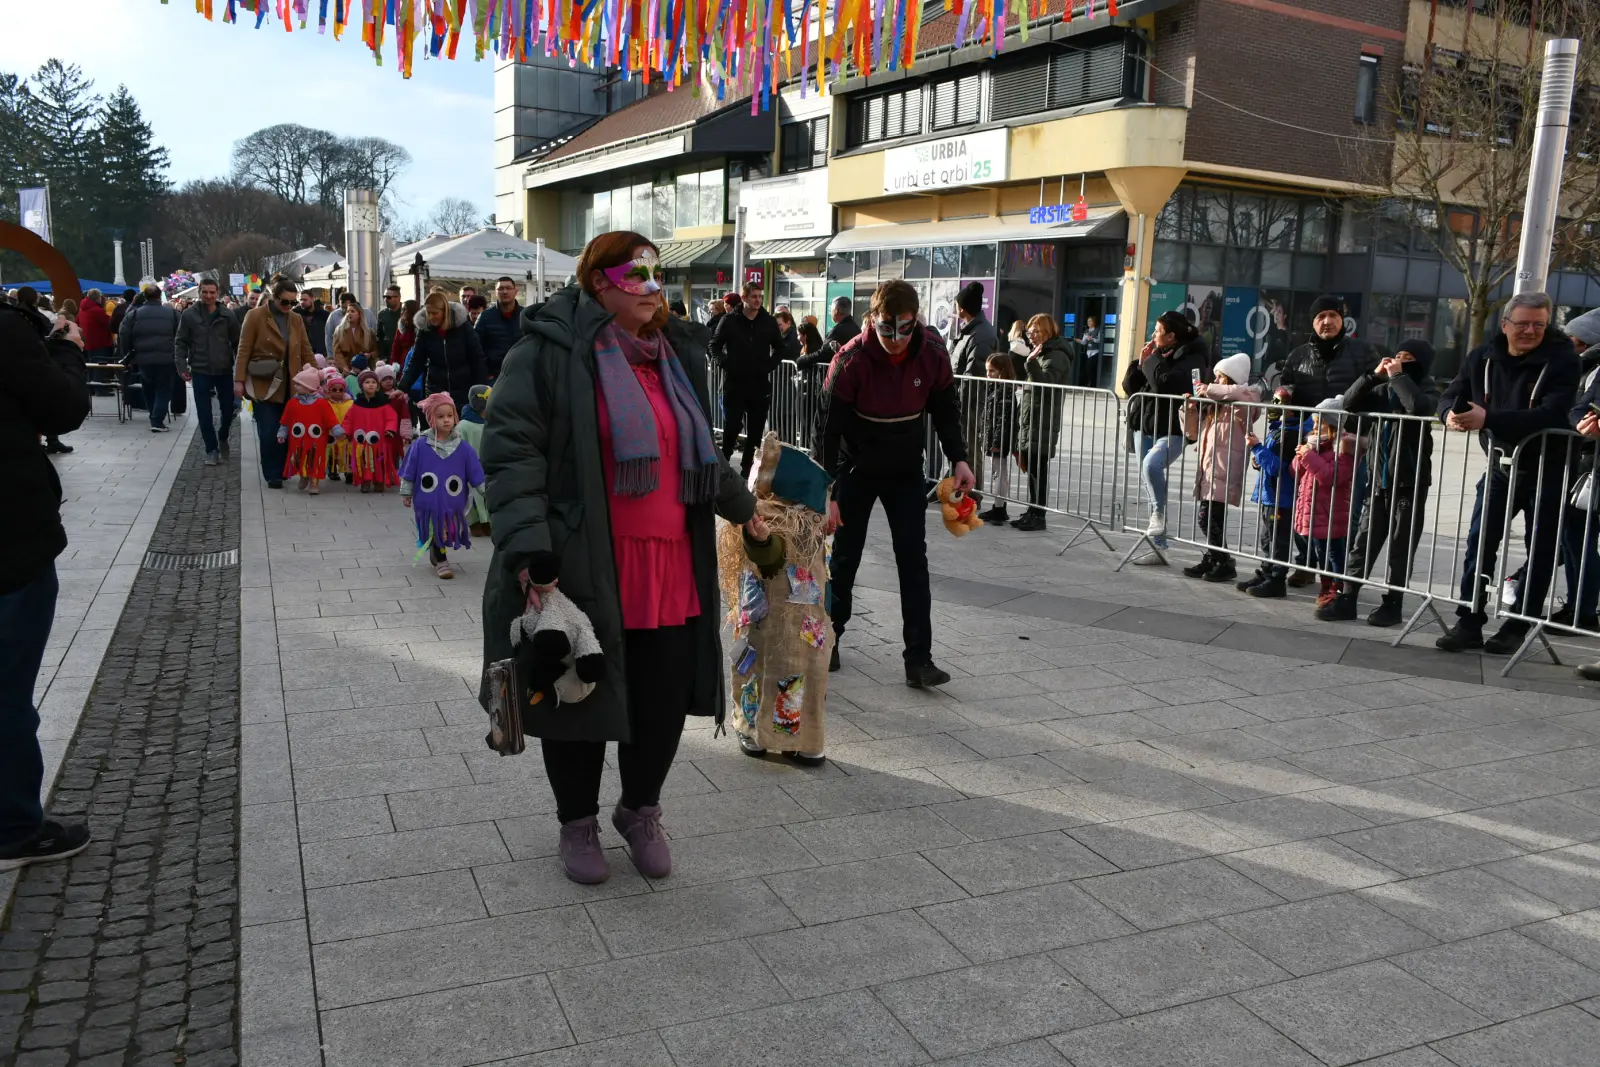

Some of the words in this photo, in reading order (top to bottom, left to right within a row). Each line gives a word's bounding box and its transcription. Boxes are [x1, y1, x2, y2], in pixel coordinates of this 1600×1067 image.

[932, 140, 967, 160] URBIA
[894, 170, 919, 189] urbi
[922, 168, 936, 186] et
[940, 163, 968, 184] orbi
[973, 160, 992, 179] 25
[1029, 204, 1072, 224] ERSTE
